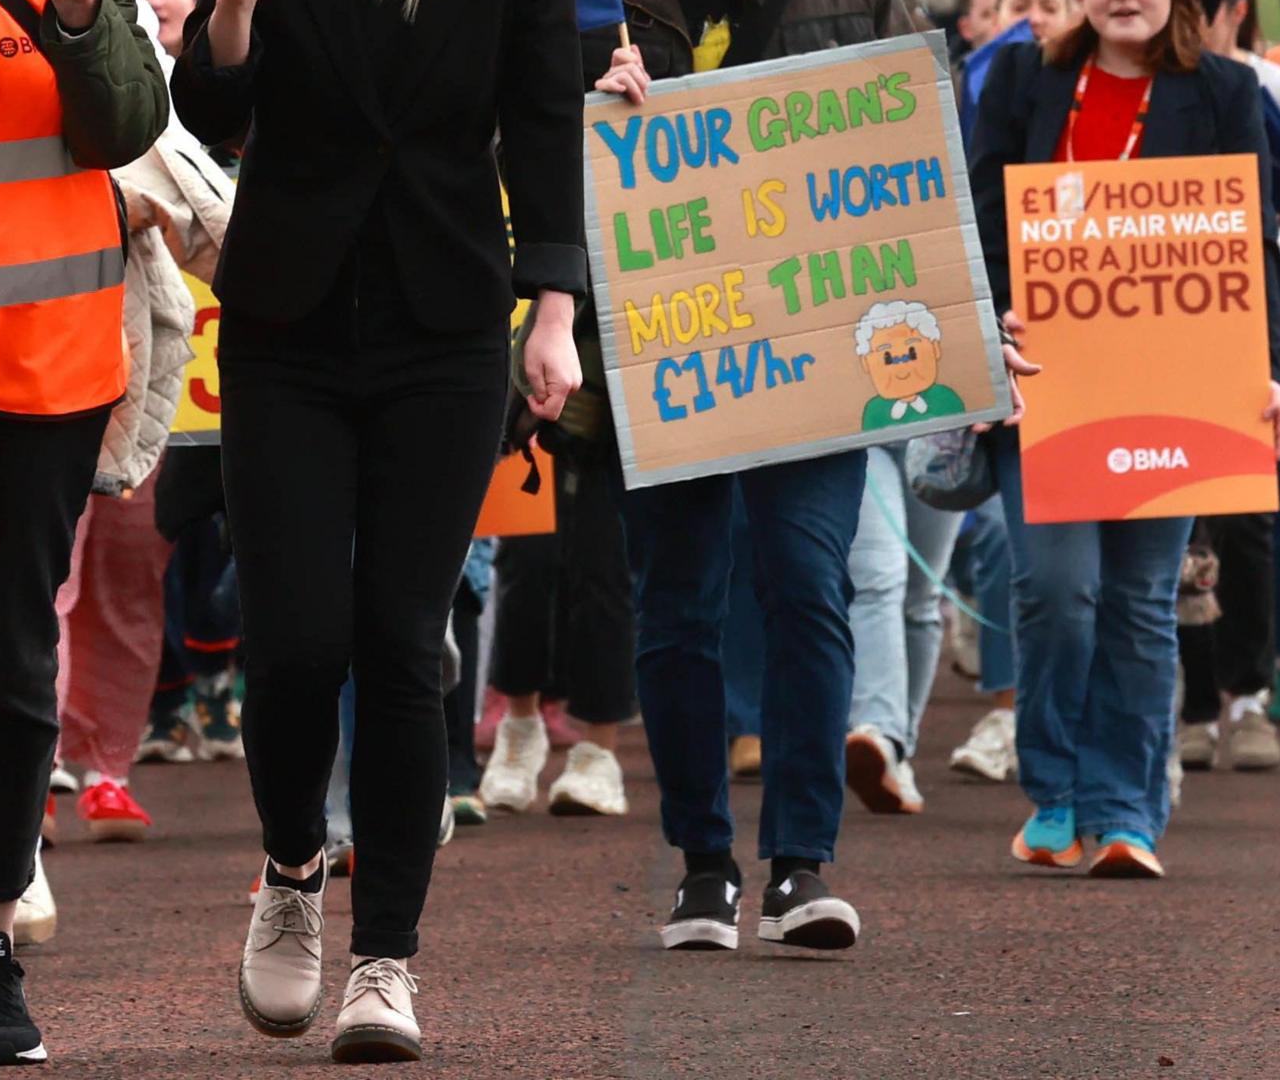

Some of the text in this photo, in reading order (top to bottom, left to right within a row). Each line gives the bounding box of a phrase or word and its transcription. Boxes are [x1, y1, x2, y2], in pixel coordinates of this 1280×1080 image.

[592, 72, 918, 190] YOUR GRAN'S
[613, 157, 946, 272] LIFE IS WORTH
[1214, 177, 1245, 205] IS
[1021, 210, 1248, 243] NOT A FAIR WAGE
[1023, 239, 1249, 275] FOR A JUNIOR
[624, 239, 918, 355] MORE THAN
[1025, 271, 1250, 322] DOCTOR
[652, 338, 816, 423] £14/hr
[1133, 447, 1189, 471] BMA
